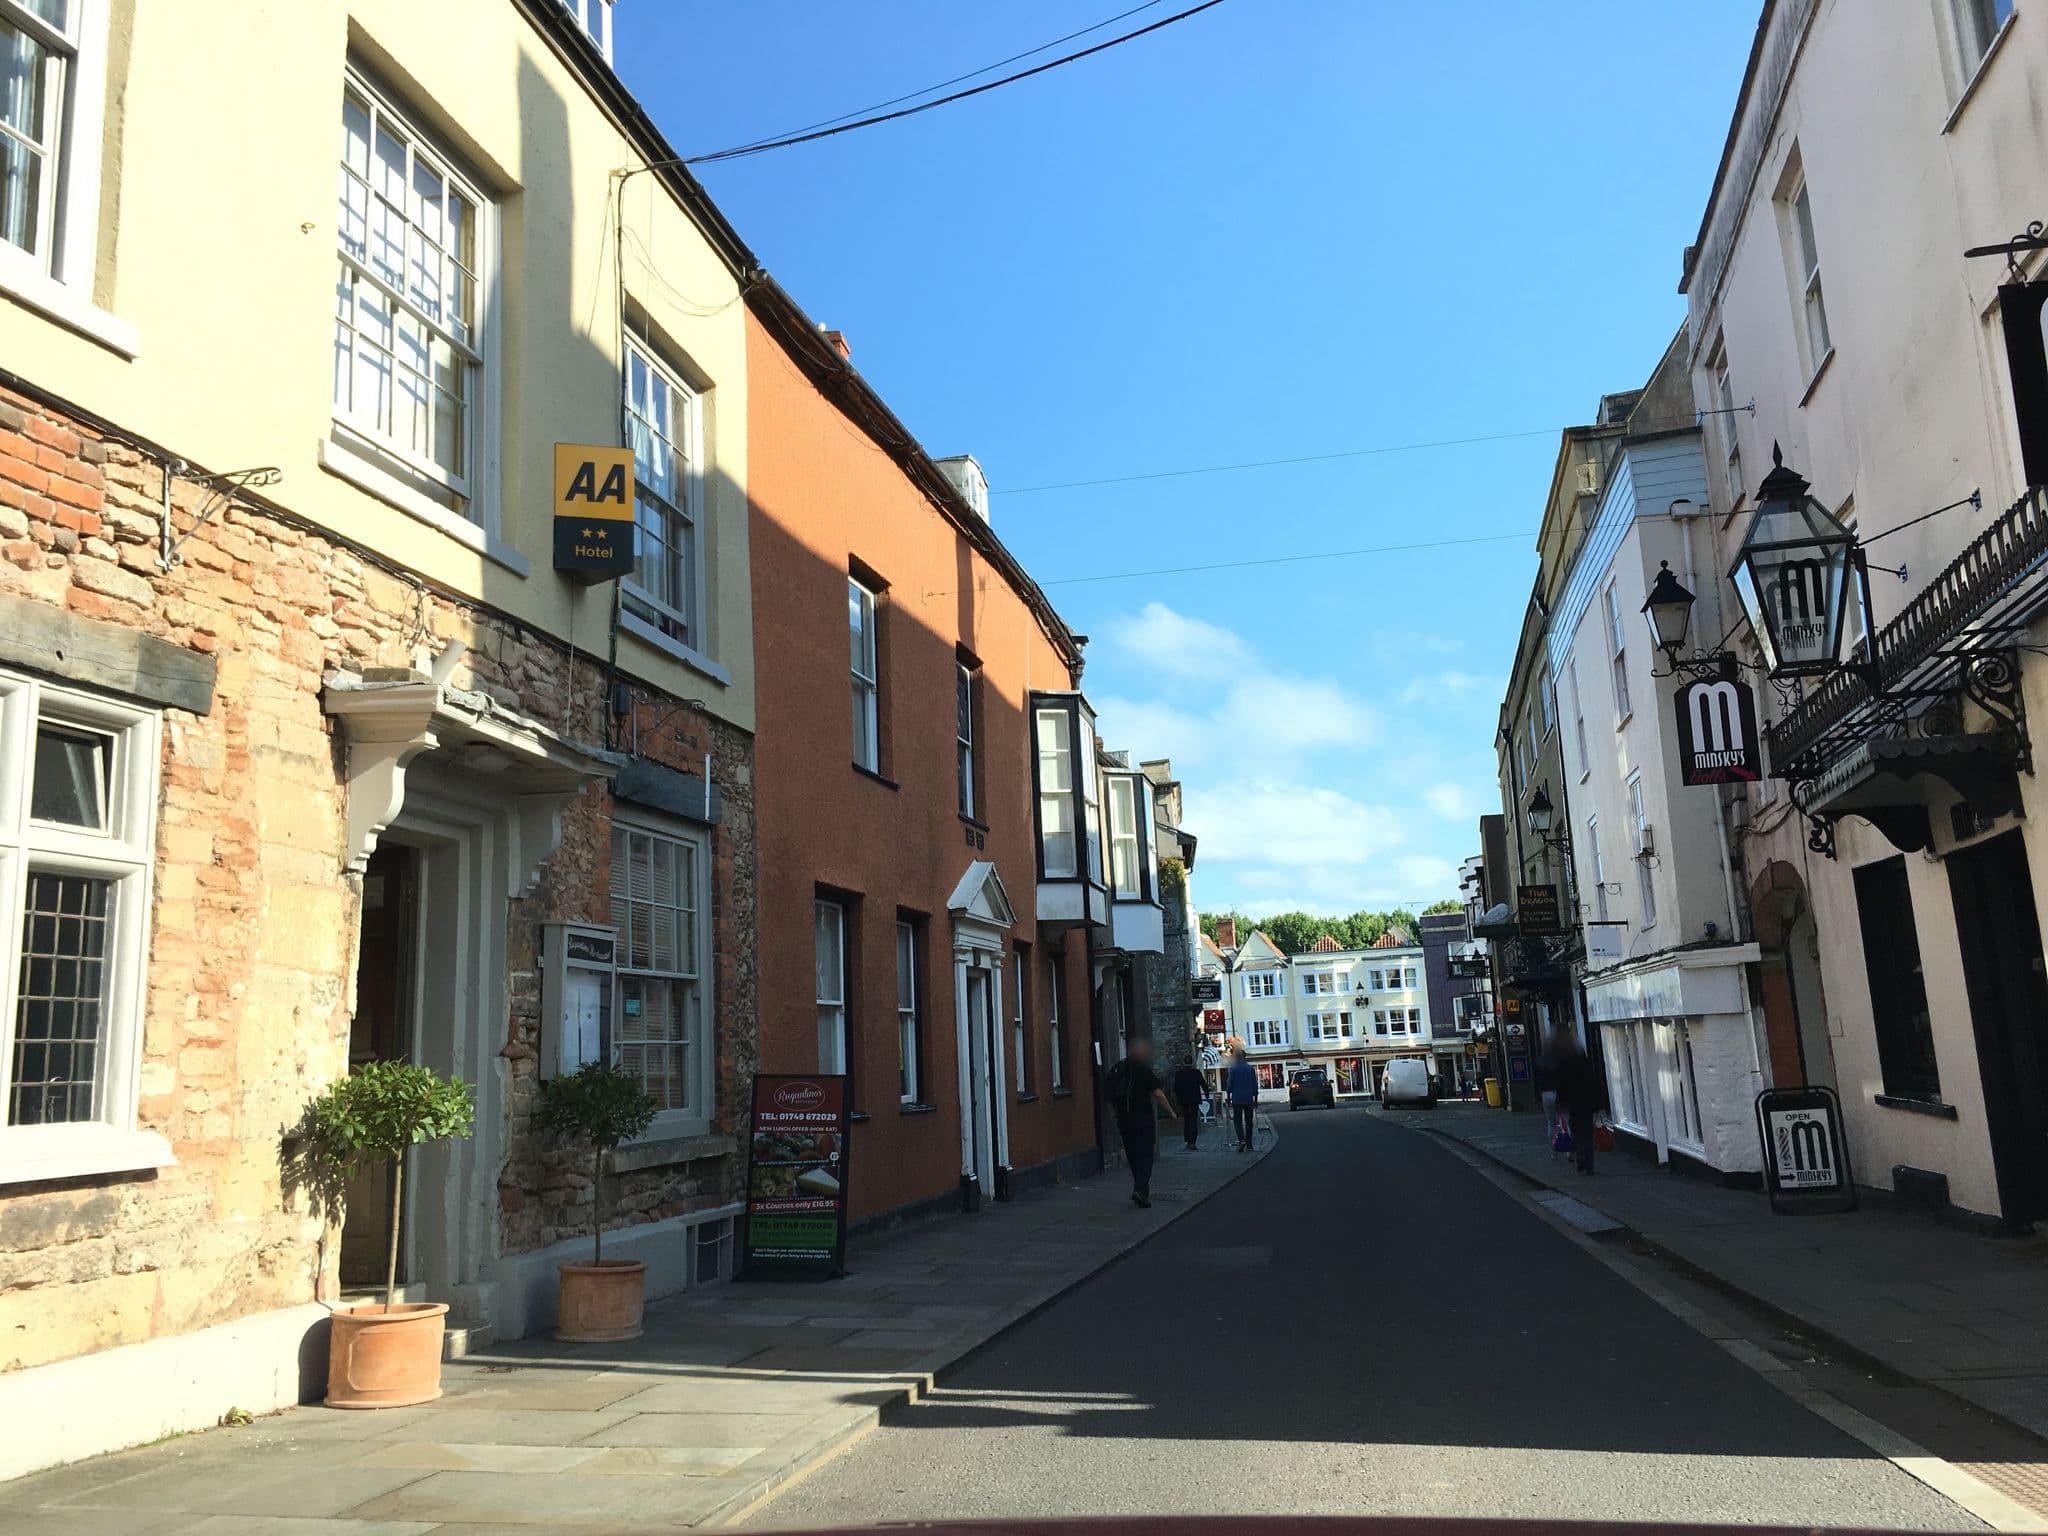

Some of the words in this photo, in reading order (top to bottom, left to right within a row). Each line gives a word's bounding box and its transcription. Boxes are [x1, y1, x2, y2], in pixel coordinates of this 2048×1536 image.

[565, 462, 625, 505] AA
[575, 545, 613, 558] Hotel
[806, 1113, 837, 1121] 672029
[1785, 1113, 1810, 1121] OPEN
[765, 1202, 794, 1210] Courses
[795, 1201, 812, 1209] only
